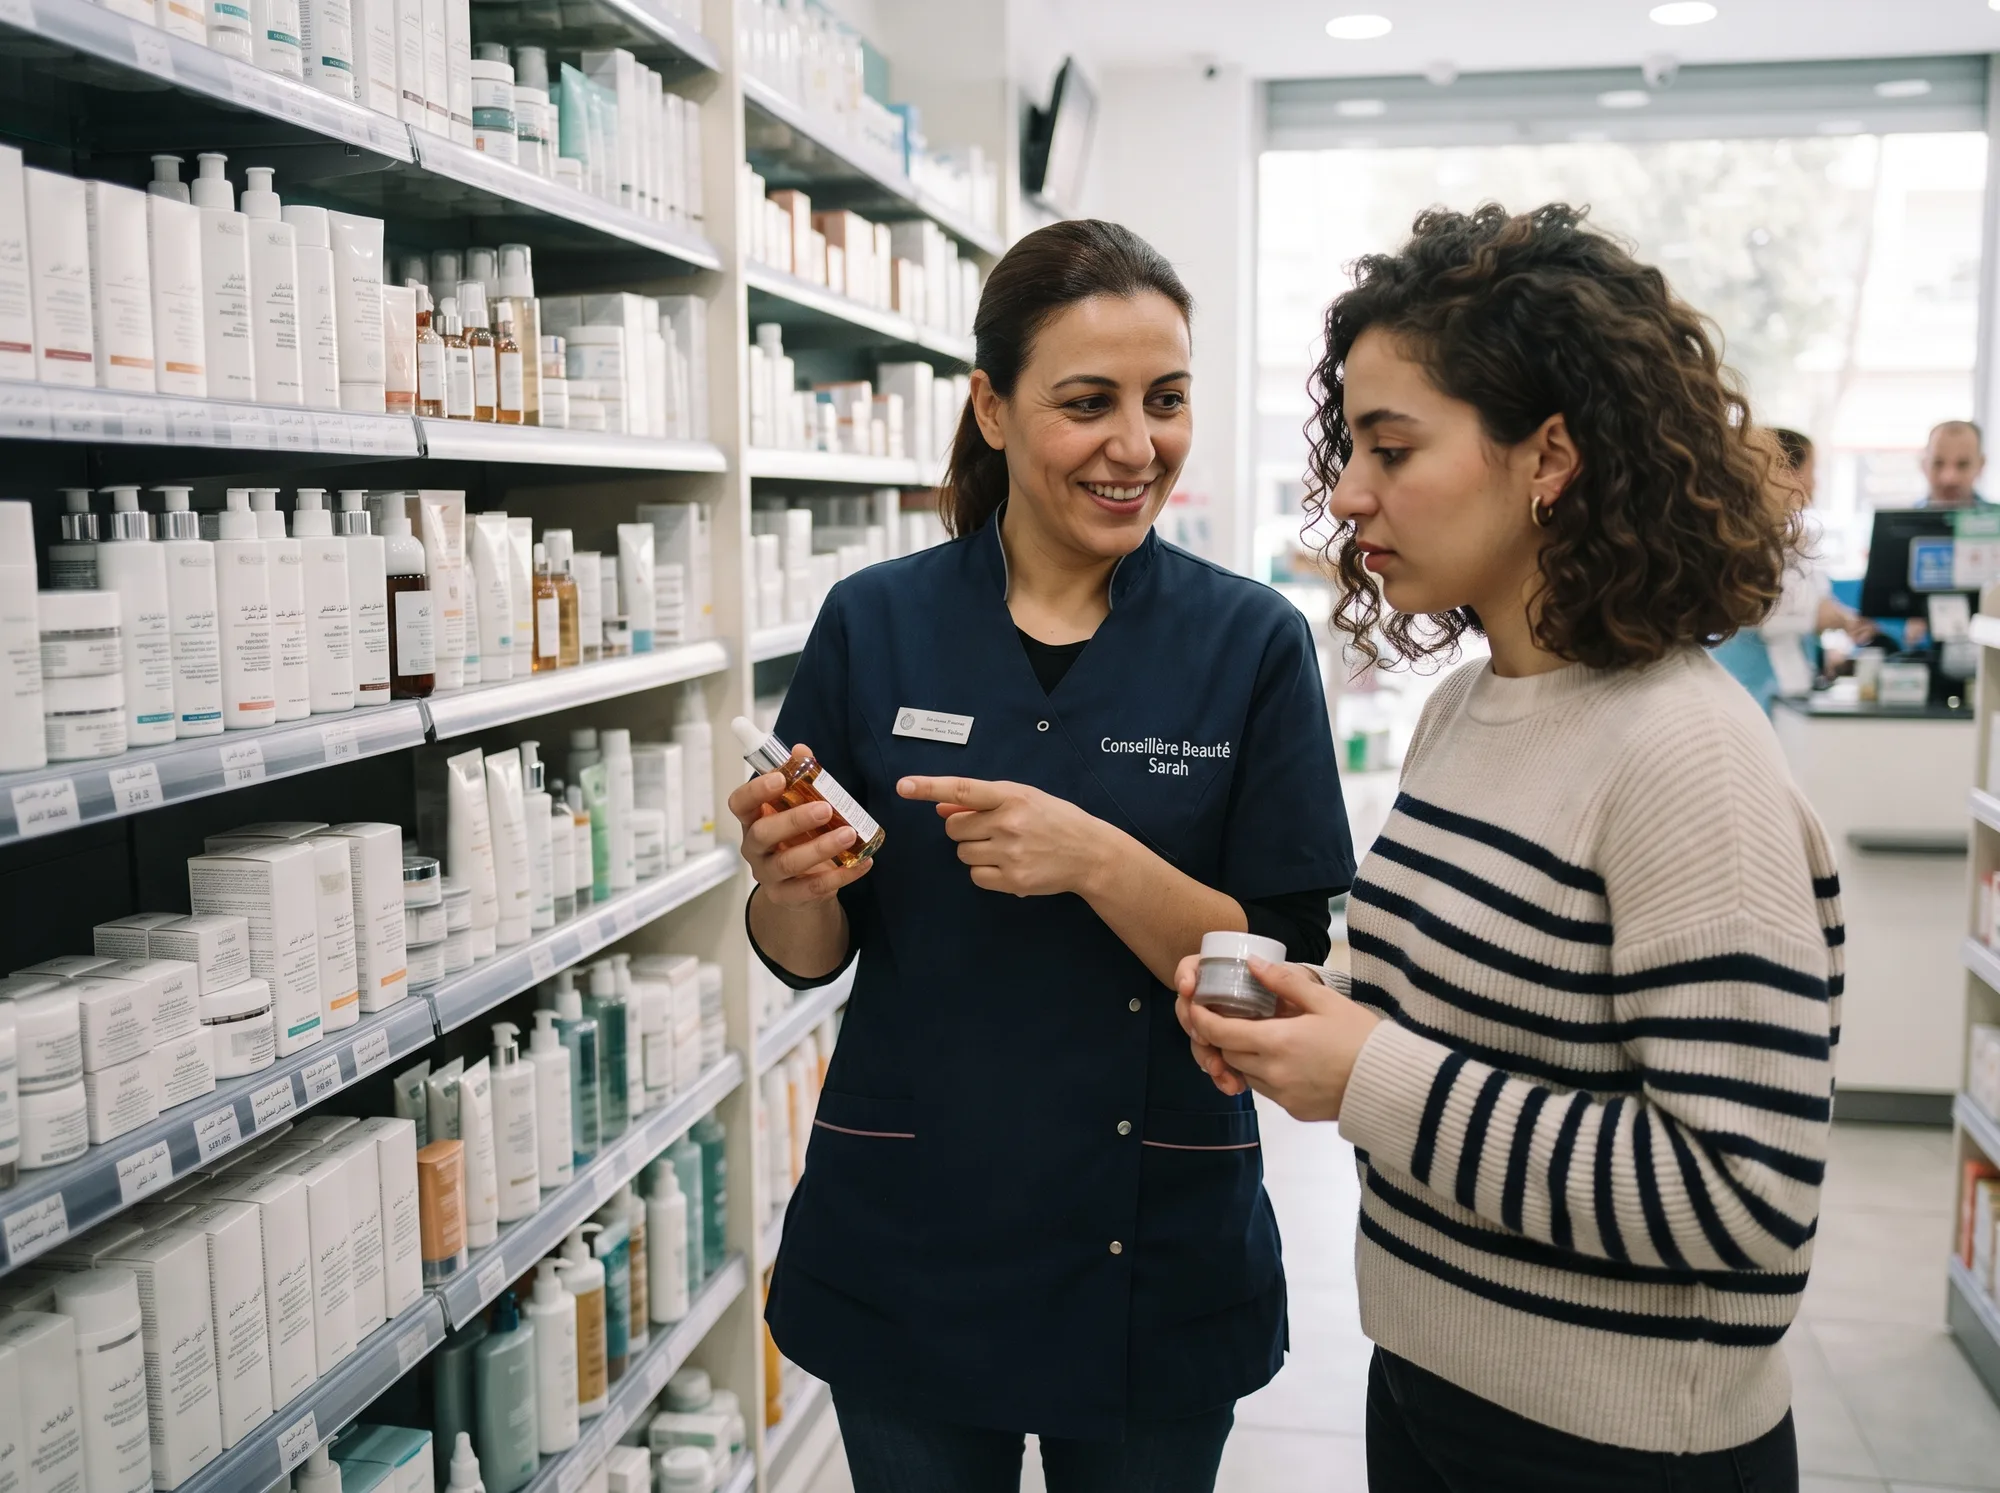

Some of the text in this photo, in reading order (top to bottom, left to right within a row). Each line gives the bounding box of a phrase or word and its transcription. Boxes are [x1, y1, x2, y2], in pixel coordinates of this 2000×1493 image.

[1101, 737, 1231, 758] Conseillère Beauté
[1148, 757, 1189, 776] Sarah
